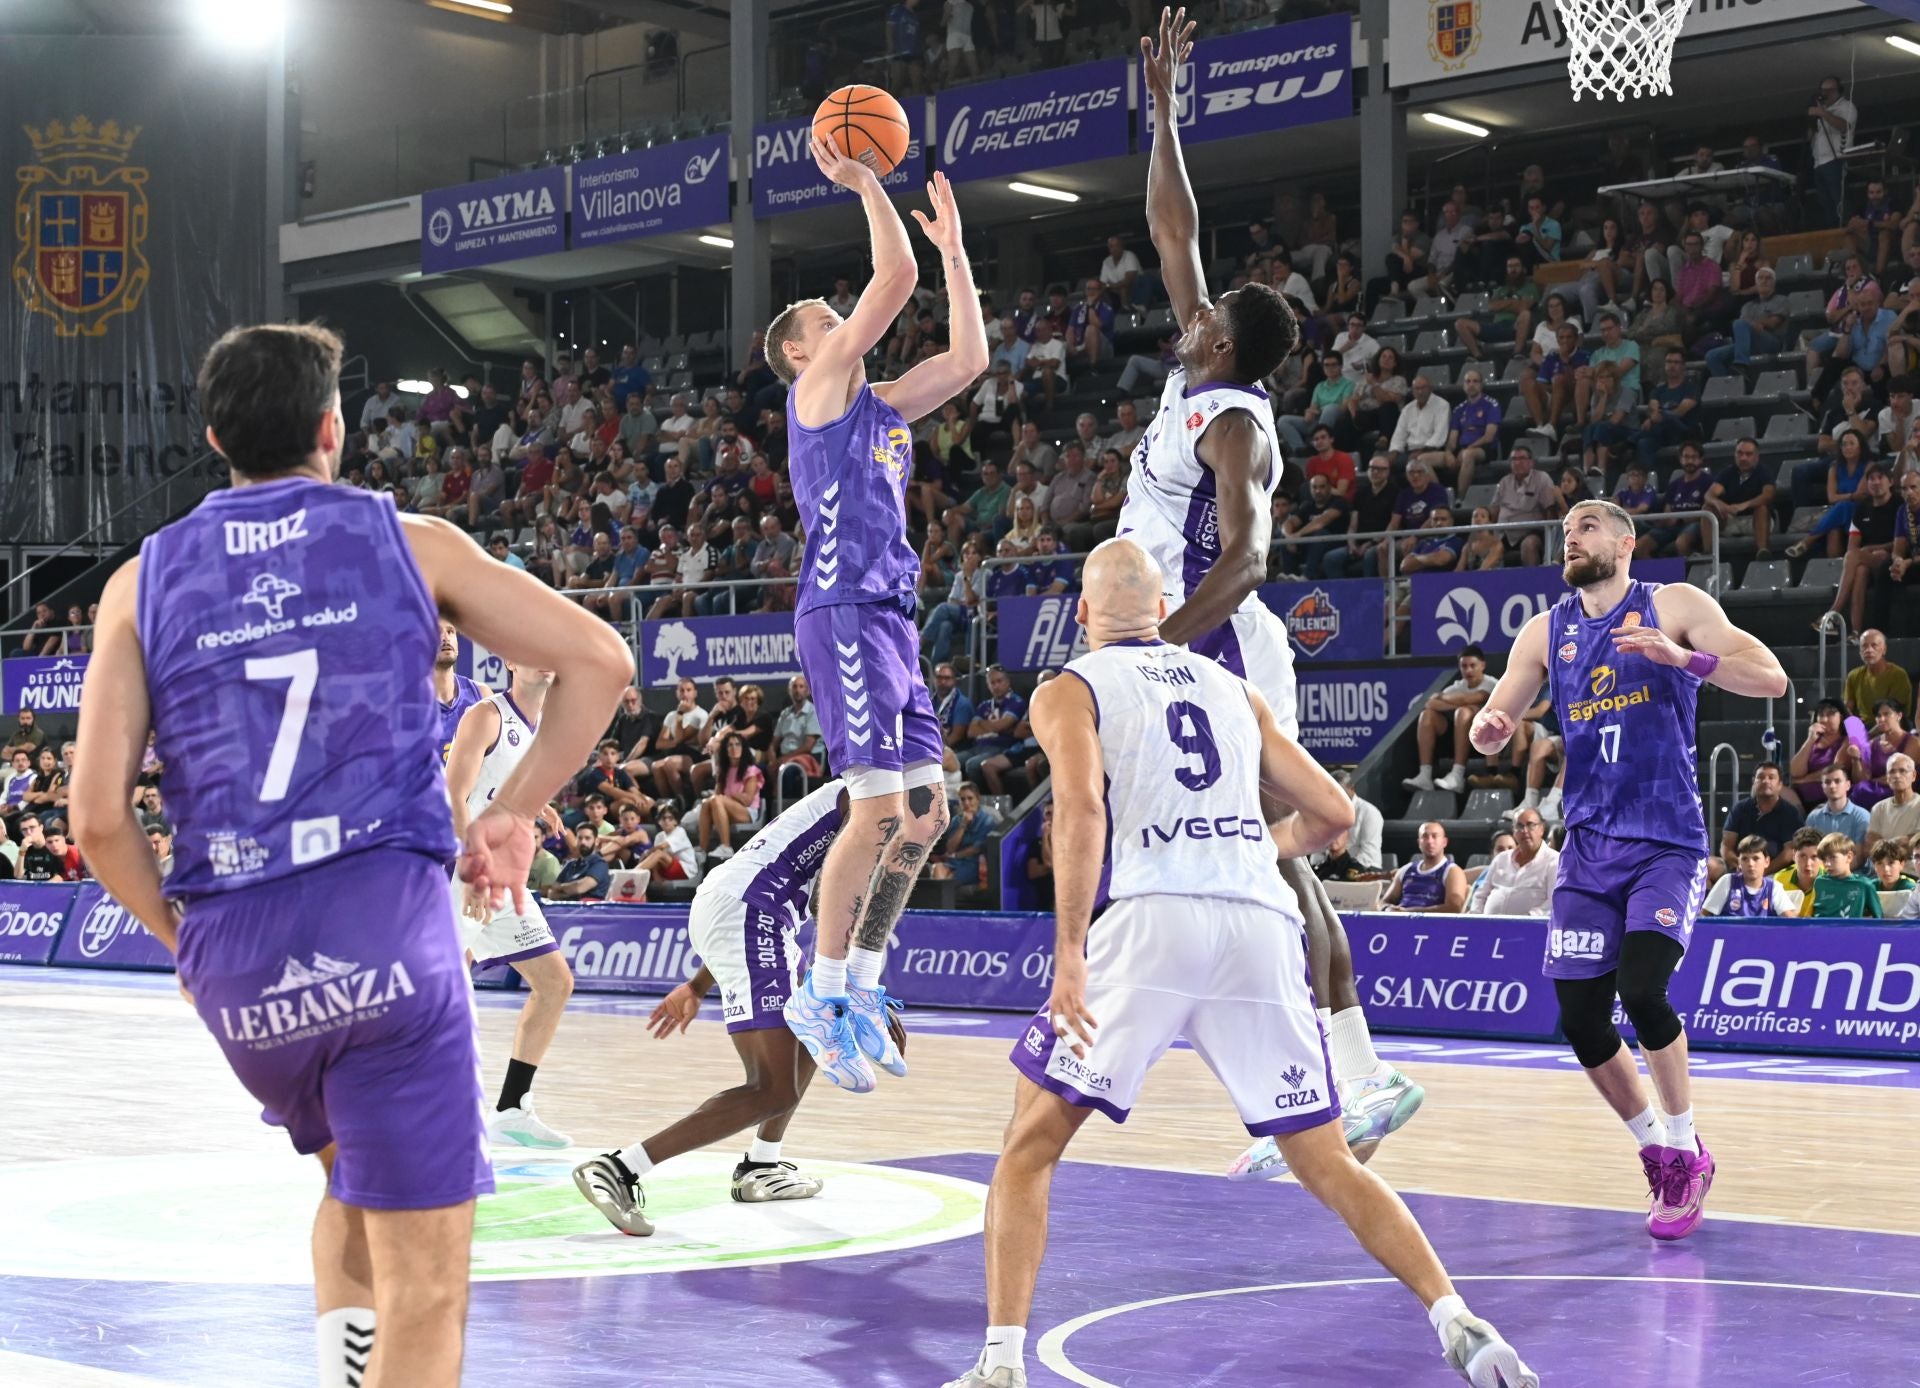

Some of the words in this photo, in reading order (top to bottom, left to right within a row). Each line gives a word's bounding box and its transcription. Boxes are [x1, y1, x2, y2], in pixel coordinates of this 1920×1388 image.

[1208, 42, 1338, 79] Transportes
[979, 86, 1121, 129] NEUMÁTICOS
[1202, 69, 1345, 115] BUJ
[969, 117, 1081, 155] PALENCIA
[579, 166, 639, 189] Interiorismo
[766, 183, 828, 205] Transporte
[458, 186, 556, 229] VAYMA
[580, 182, 681, 222] Villanova
[455, 237, 487, 251] LIMPIEZA
[490, 236, 495, 245] Y
[498, 224, 558, 244] MANTENIMIENTO
[197, 618, 297, 650] recoletas
[302, 601, 358, 627] salud
[1023, 598, 1090, 668] AL
[1289, 616, 1336, 632] PALENCIA
[29, 671, 86, 685] DESGUA
[20, 683, 82, 710] MUND
[1296, 681, 1389, 723] VENIDOS
[1567, 699, 1593, 710] super
[1569, 685, 1651, 722] agropal
[244, 648, 319, 802] 7
[1299, 726, 1372, 738] NTIMIENTO
[1166, 700, 1222, 791] 9
[1302, 737, 1358, 748] ENTINO.
[1598, 723, 1622, 763] 17
[1142, 816, 1262, 849] IVECO
[1369, 933, 1504, 959] OTEL
[1550, 929, 1604, 958] gaza
[902, 948, 1009, 977] ramos
[1699, 938, 1920, 1013] lamb
[220, 960, 416, 1041] LEBANZA
[761, 995, 785, 1008] CBC
[1369, 975, 1528, 1014] SANCHO
[1026, 1025, 1045, 1052] CBC
[1693, 1008, 1811, 1036] frigoríficas
[1836, 1019, 1920, 1044] www.p
[1059, 1056, 1112, 1089] SYNERGIA
[1275, 1088, 1320, 1109] CRZA
